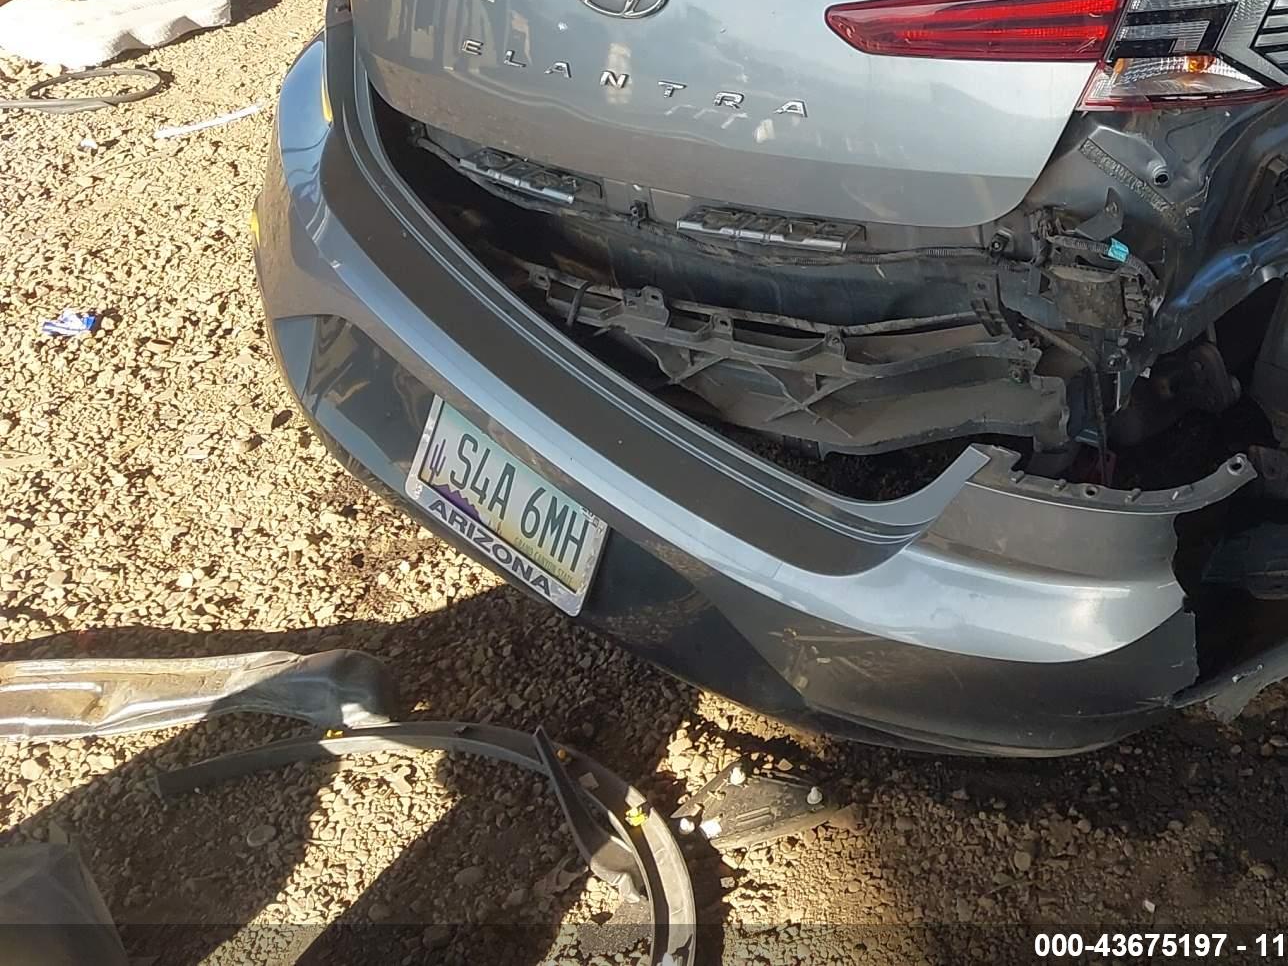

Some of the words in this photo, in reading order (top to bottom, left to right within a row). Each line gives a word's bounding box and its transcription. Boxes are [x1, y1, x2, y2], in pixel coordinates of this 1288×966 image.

[461, 38, 809, 119] ELANTRA
[428, 498, 553, 598] ARIZONA
[450, 433, 516, 520] S4A
[520, 487, 589, 572] 6MH
